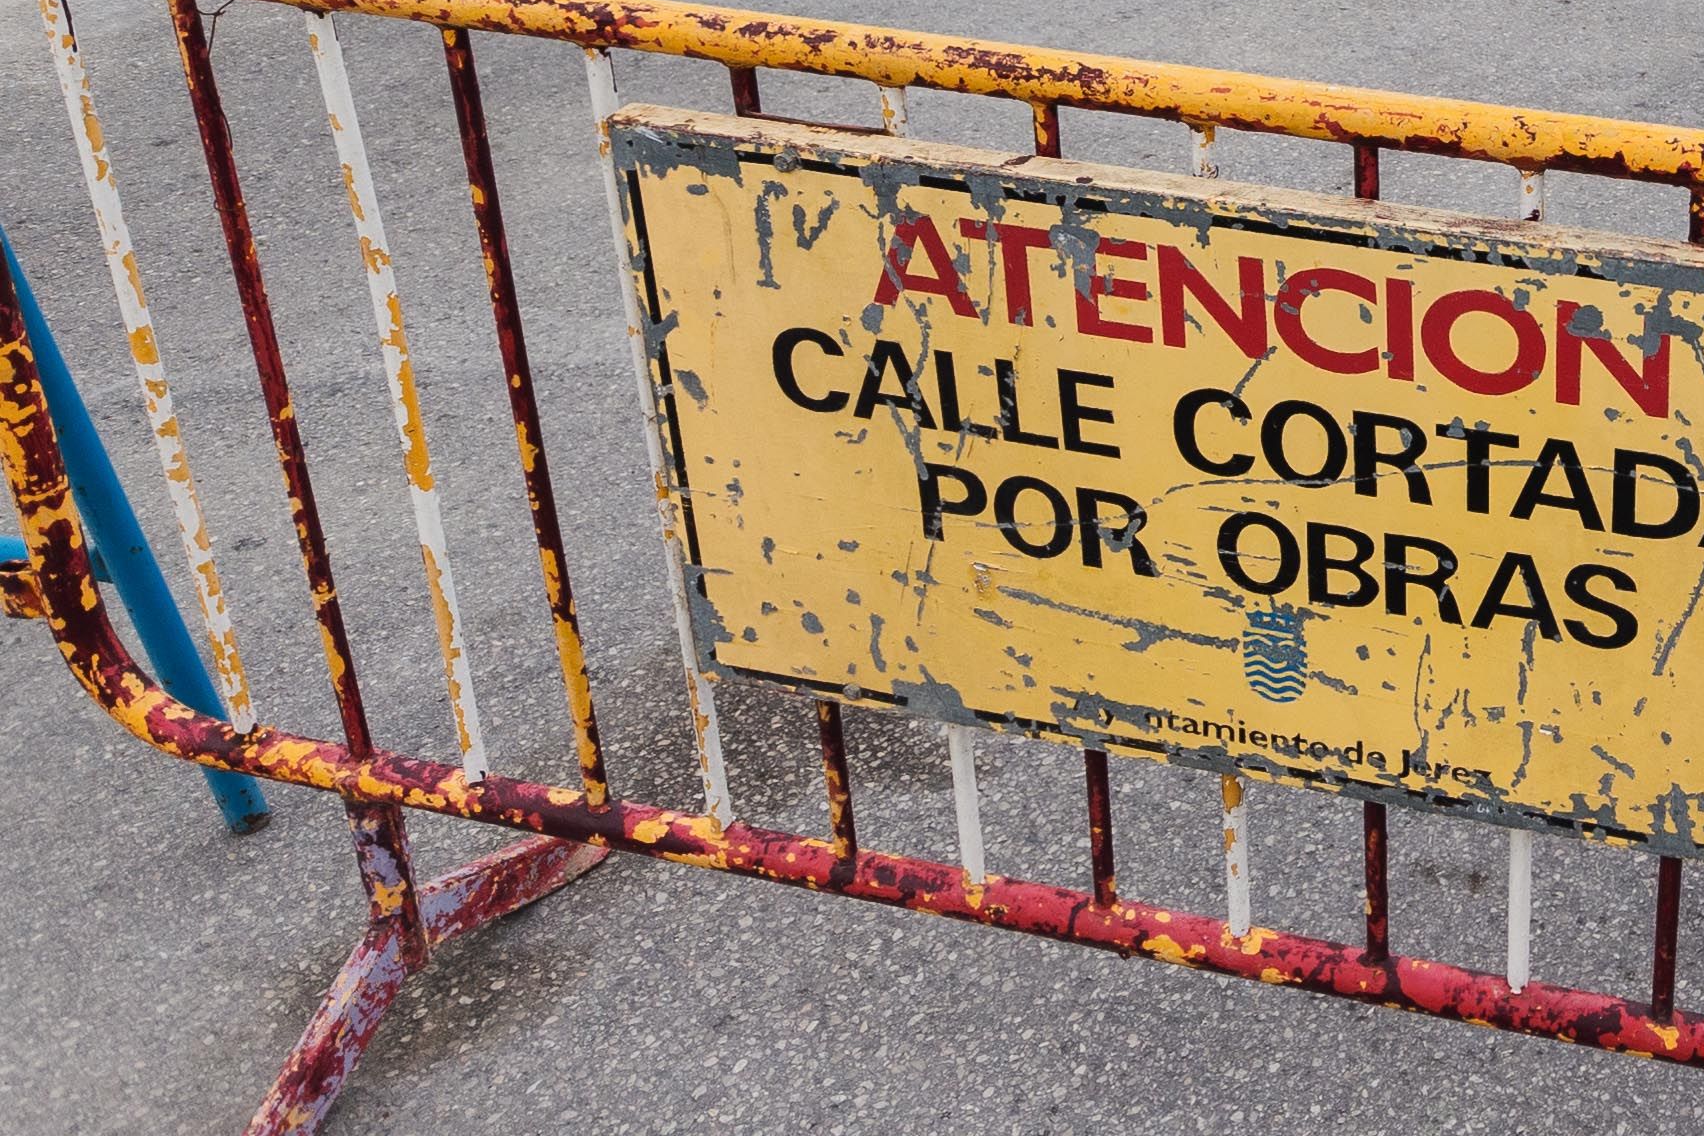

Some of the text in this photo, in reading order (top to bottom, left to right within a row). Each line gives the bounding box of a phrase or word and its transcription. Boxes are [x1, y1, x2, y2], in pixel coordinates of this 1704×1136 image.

[772, 327, 1121, 459] CALLE
[873, 216, 1671, 418] ATENCION
[917, 461, 1640, 651] POR OBRAS
[1072, 696, 1329, 761] yntamiento
[1343, 740, 1387, 768] de
